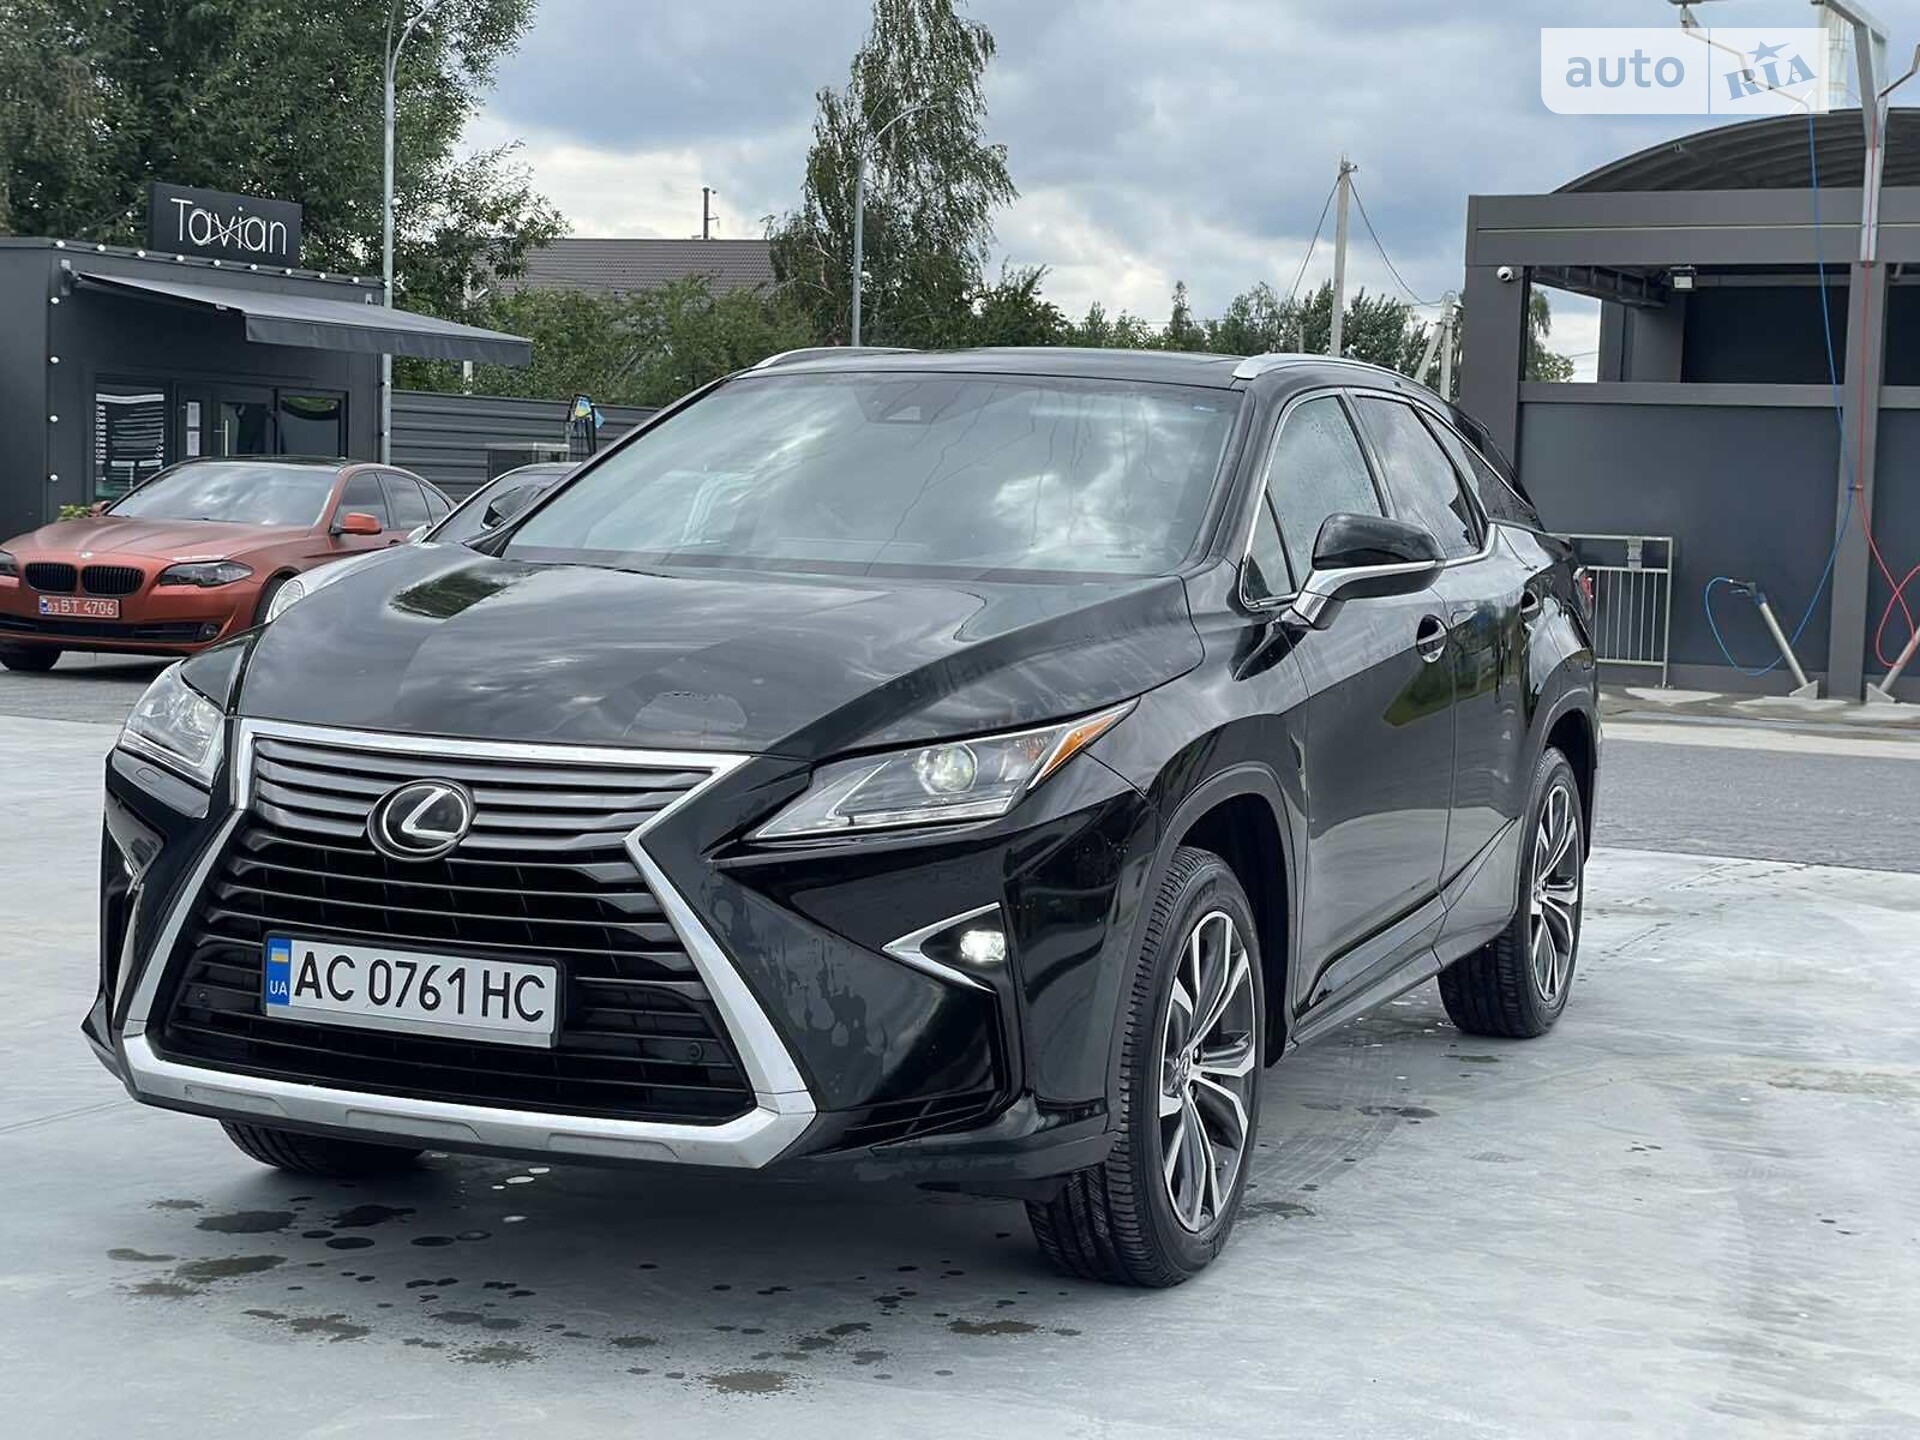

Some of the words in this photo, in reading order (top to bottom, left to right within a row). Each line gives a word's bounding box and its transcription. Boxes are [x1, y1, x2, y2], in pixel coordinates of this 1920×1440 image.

[60, 600, 79, 613] BT
[84, 601, 115, 615] 4706
[269, 980, 288, 996] UA
[294, 951, 356, 1001] AC
[368, 959, 465, 1015] 0761
[481, 970, 545, 1022] HC
